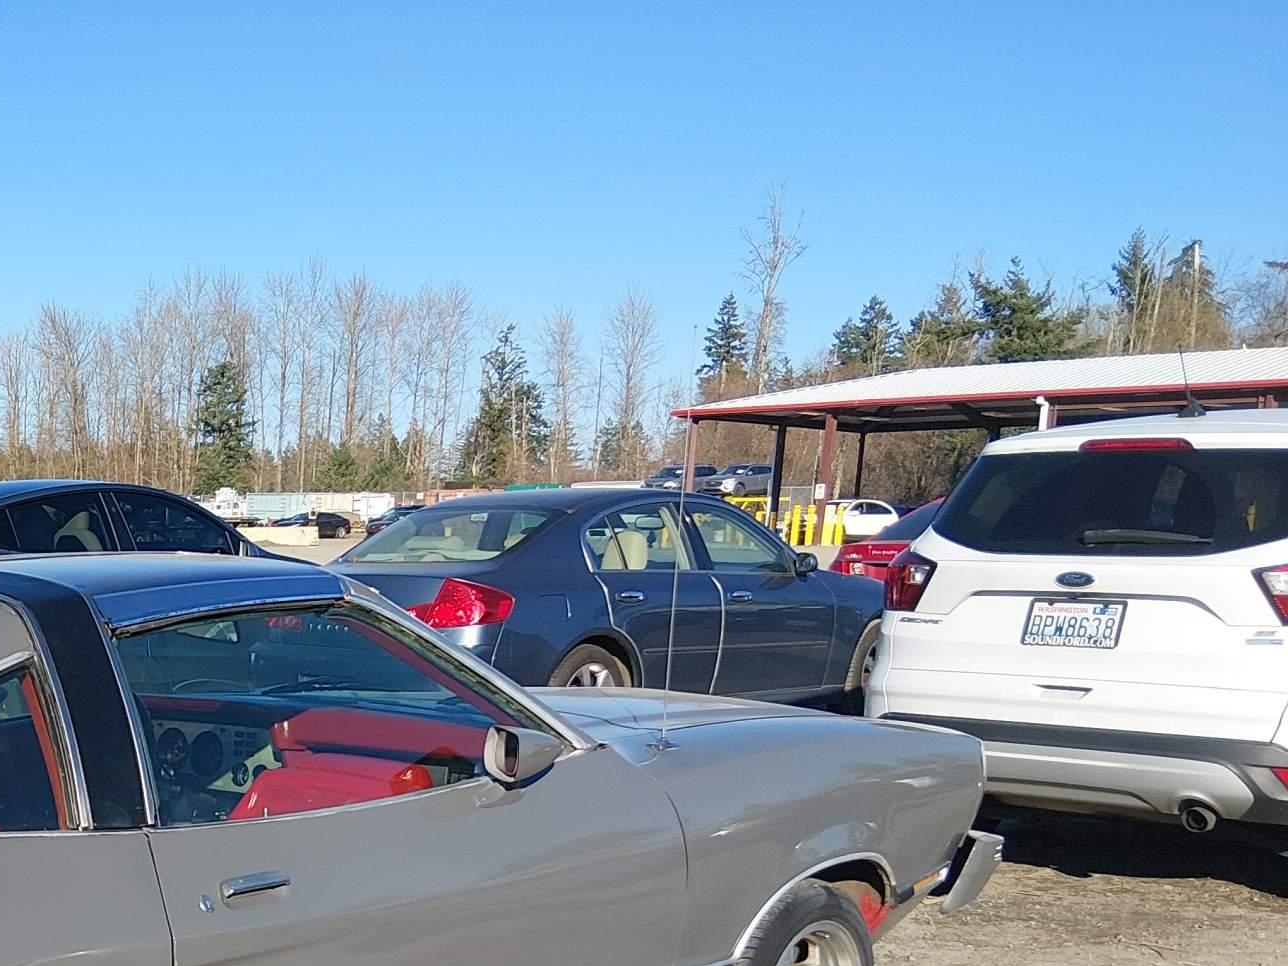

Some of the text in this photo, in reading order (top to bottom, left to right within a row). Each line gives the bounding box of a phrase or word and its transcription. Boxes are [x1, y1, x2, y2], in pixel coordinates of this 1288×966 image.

[1038, 606, 1089, 614] WASHINGTON
[1029, 614, 1116, 640] BPW8638
[1023, 633, 1116, 649] SOUNDFORD.COM
